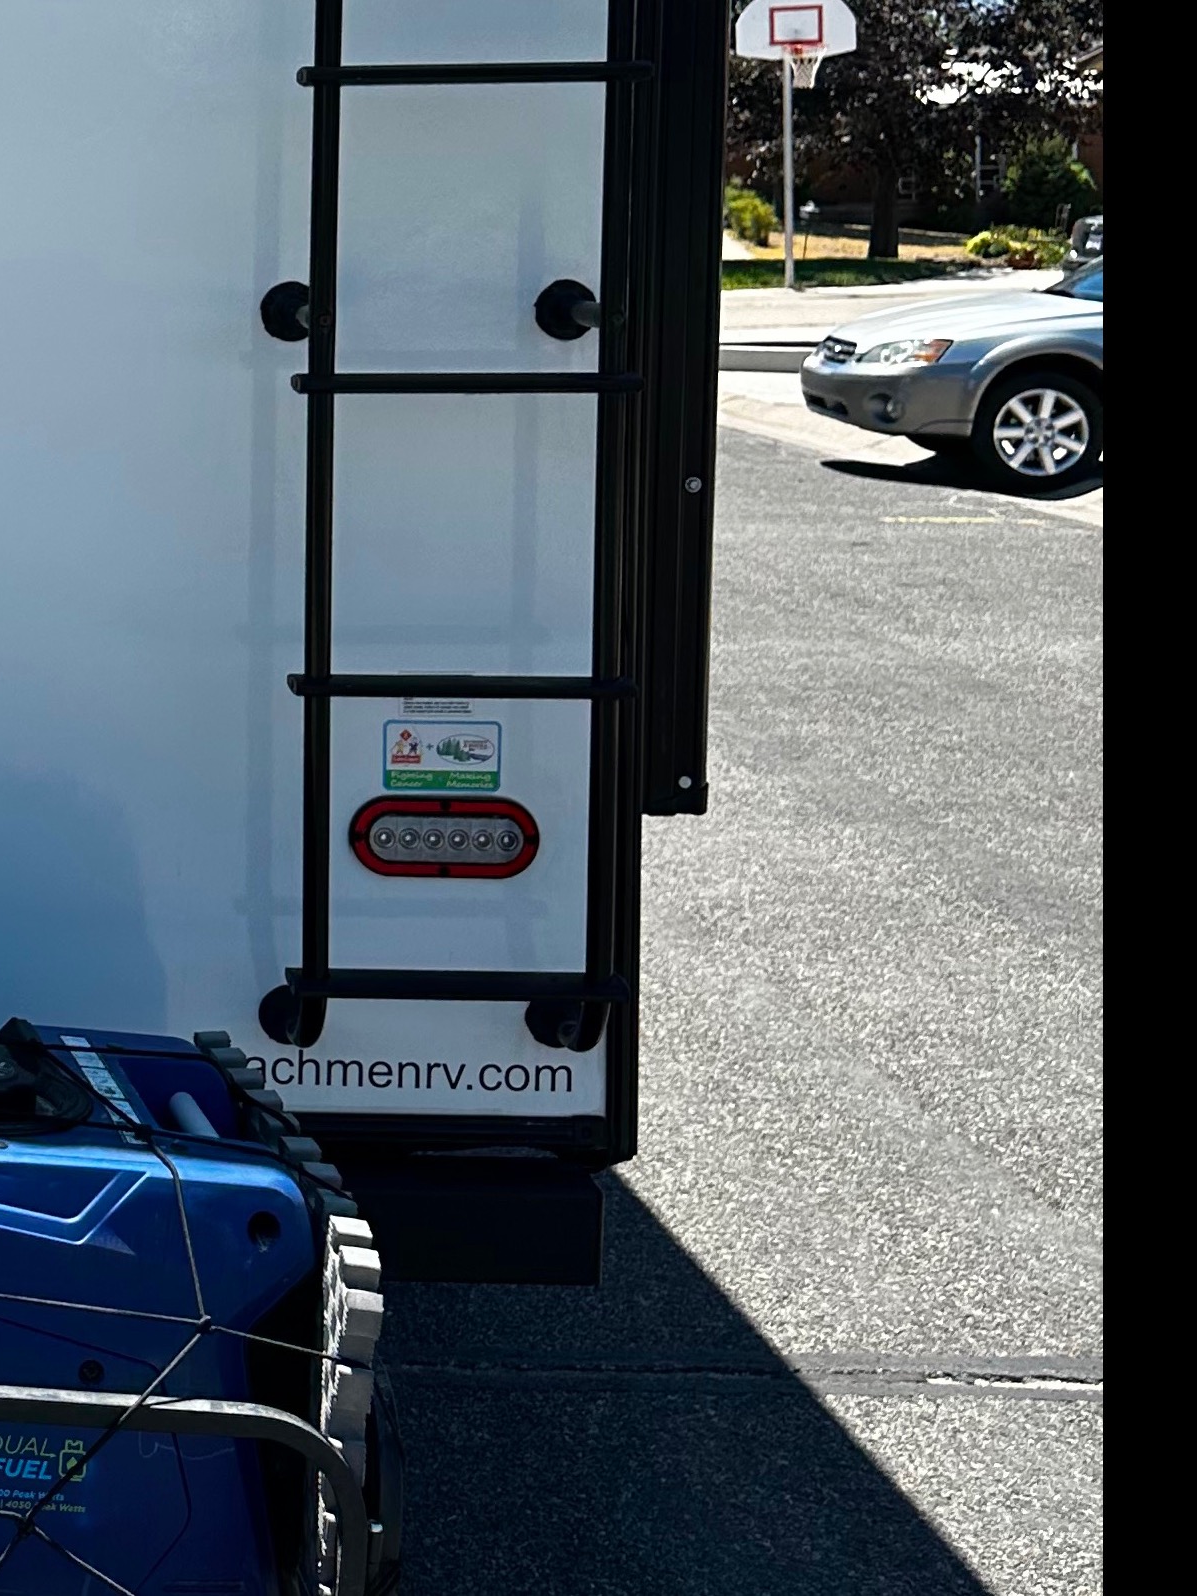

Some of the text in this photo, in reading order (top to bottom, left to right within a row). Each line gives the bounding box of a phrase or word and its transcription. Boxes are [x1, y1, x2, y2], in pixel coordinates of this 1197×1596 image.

[12, 1489, 36, 1499] Peak
[37, 1490, 65, 1501] Wtts
[5, 1500, 32, 1510] 4050
[59, 1503, 87, 1513] Watts
